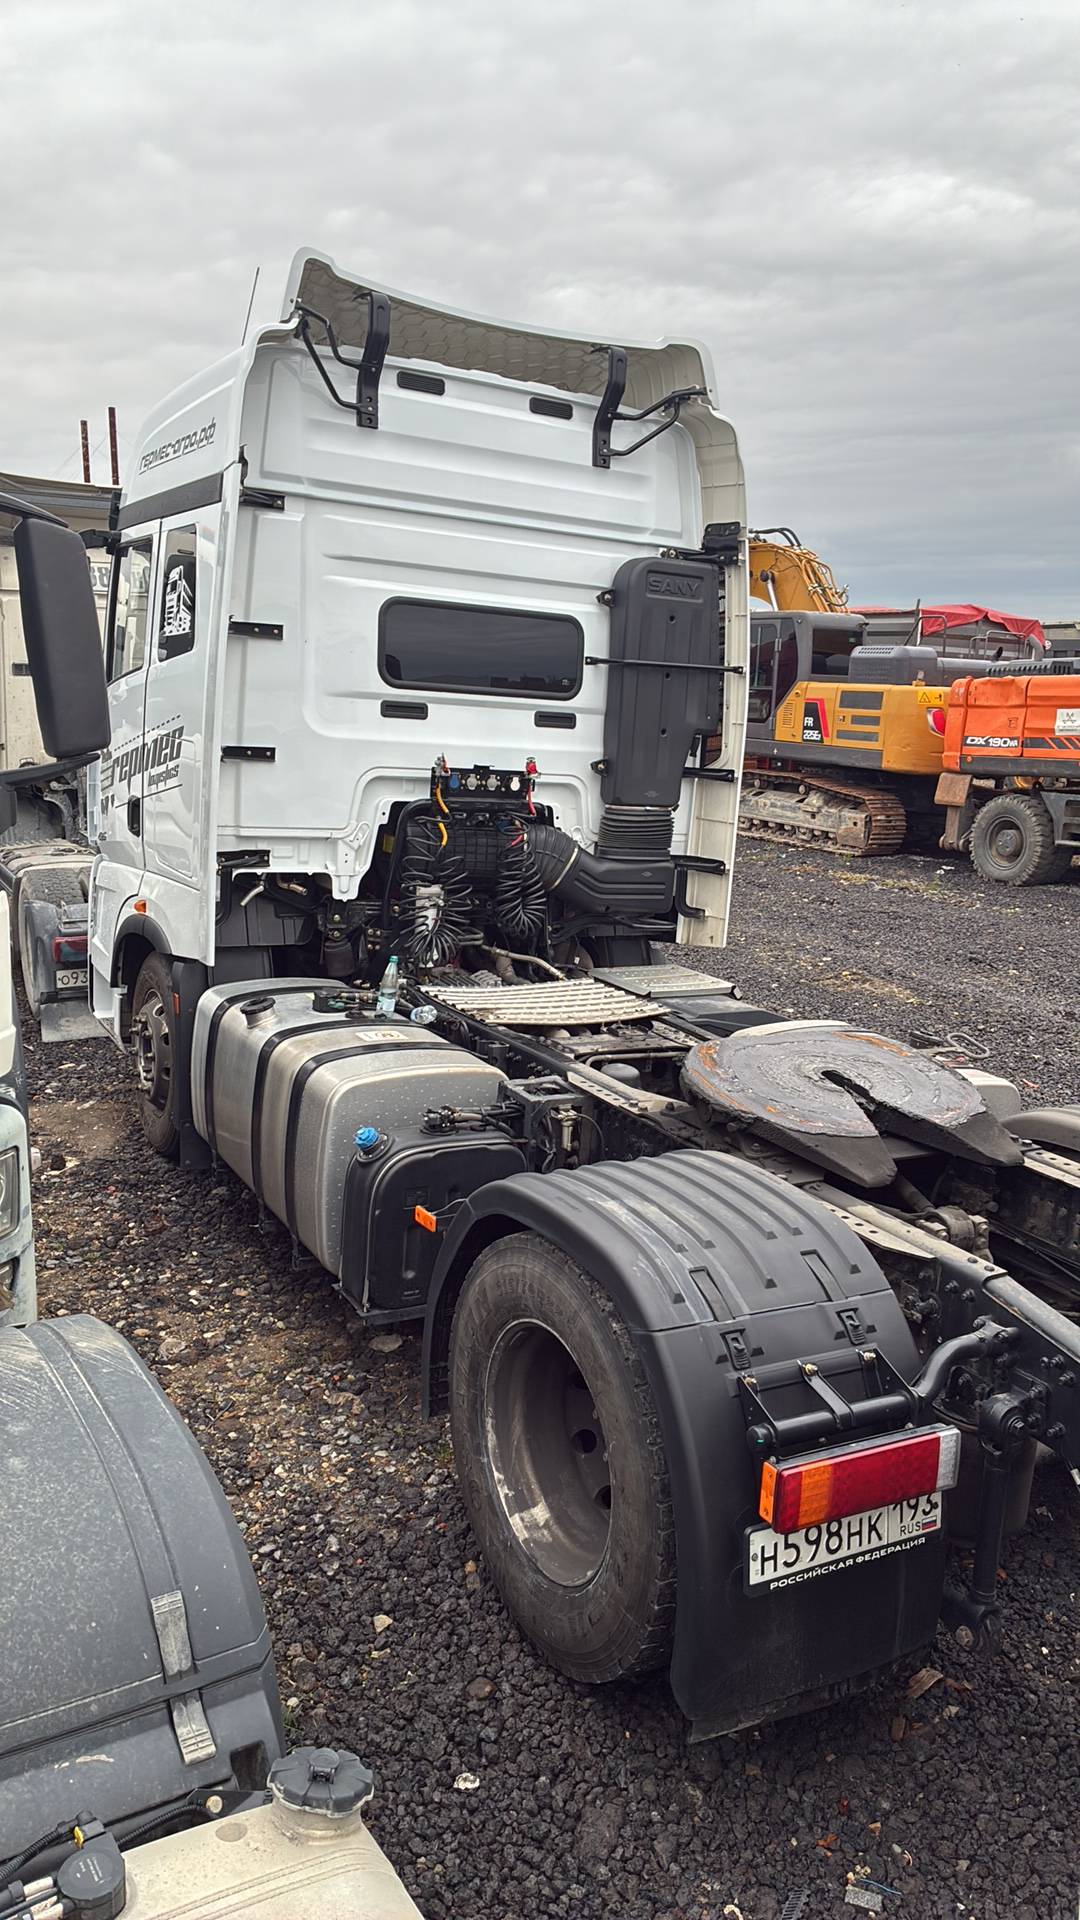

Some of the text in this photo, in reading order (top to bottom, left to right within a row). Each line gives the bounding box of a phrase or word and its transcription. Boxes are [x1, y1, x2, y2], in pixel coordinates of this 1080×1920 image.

[648, 576, 699, 597] SANY
[803, 716, 814, 727] FR
[899, 1519, 922, 1537] RUS
[769, 1536, 926, 1591] РОССИЙСКАЯ ФЕДЕРАЦИЯ
